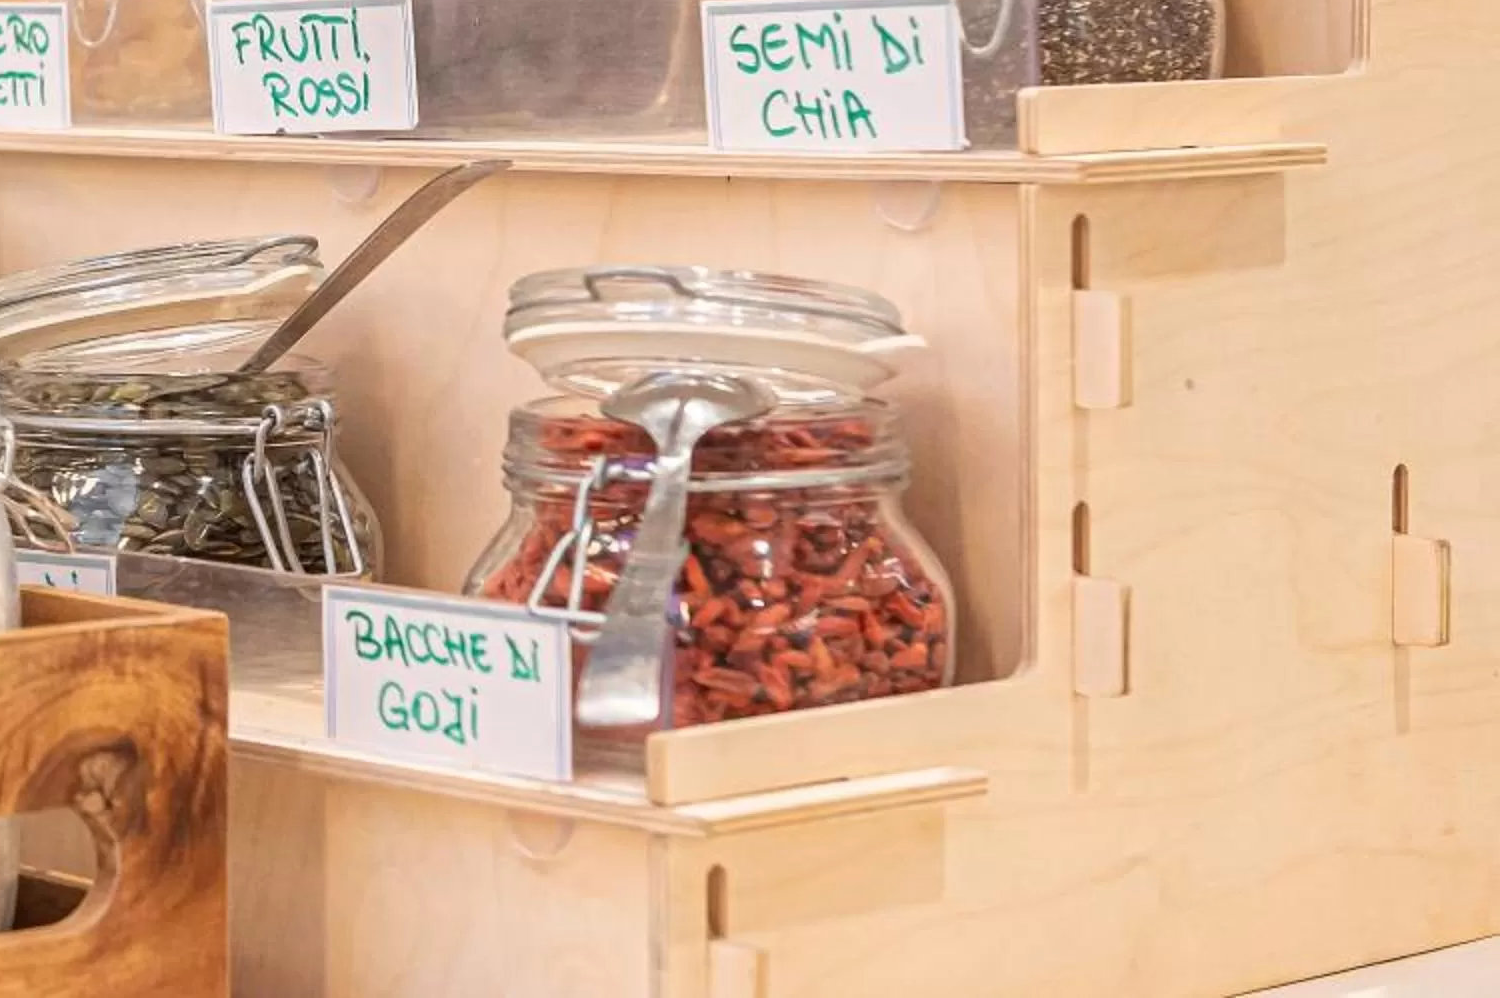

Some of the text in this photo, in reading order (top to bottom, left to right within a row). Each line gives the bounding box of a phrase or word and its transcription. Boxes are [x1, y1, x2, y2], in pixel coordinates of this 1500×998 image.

[730, 11, 924, 74] SEMI DI
[263, 54, 370, 117] ROSSI
[762, 88, 877, 139] CHIA
[345, 610, 492, 673] BACCHE
[378, 682, 478, 745] GOJI
